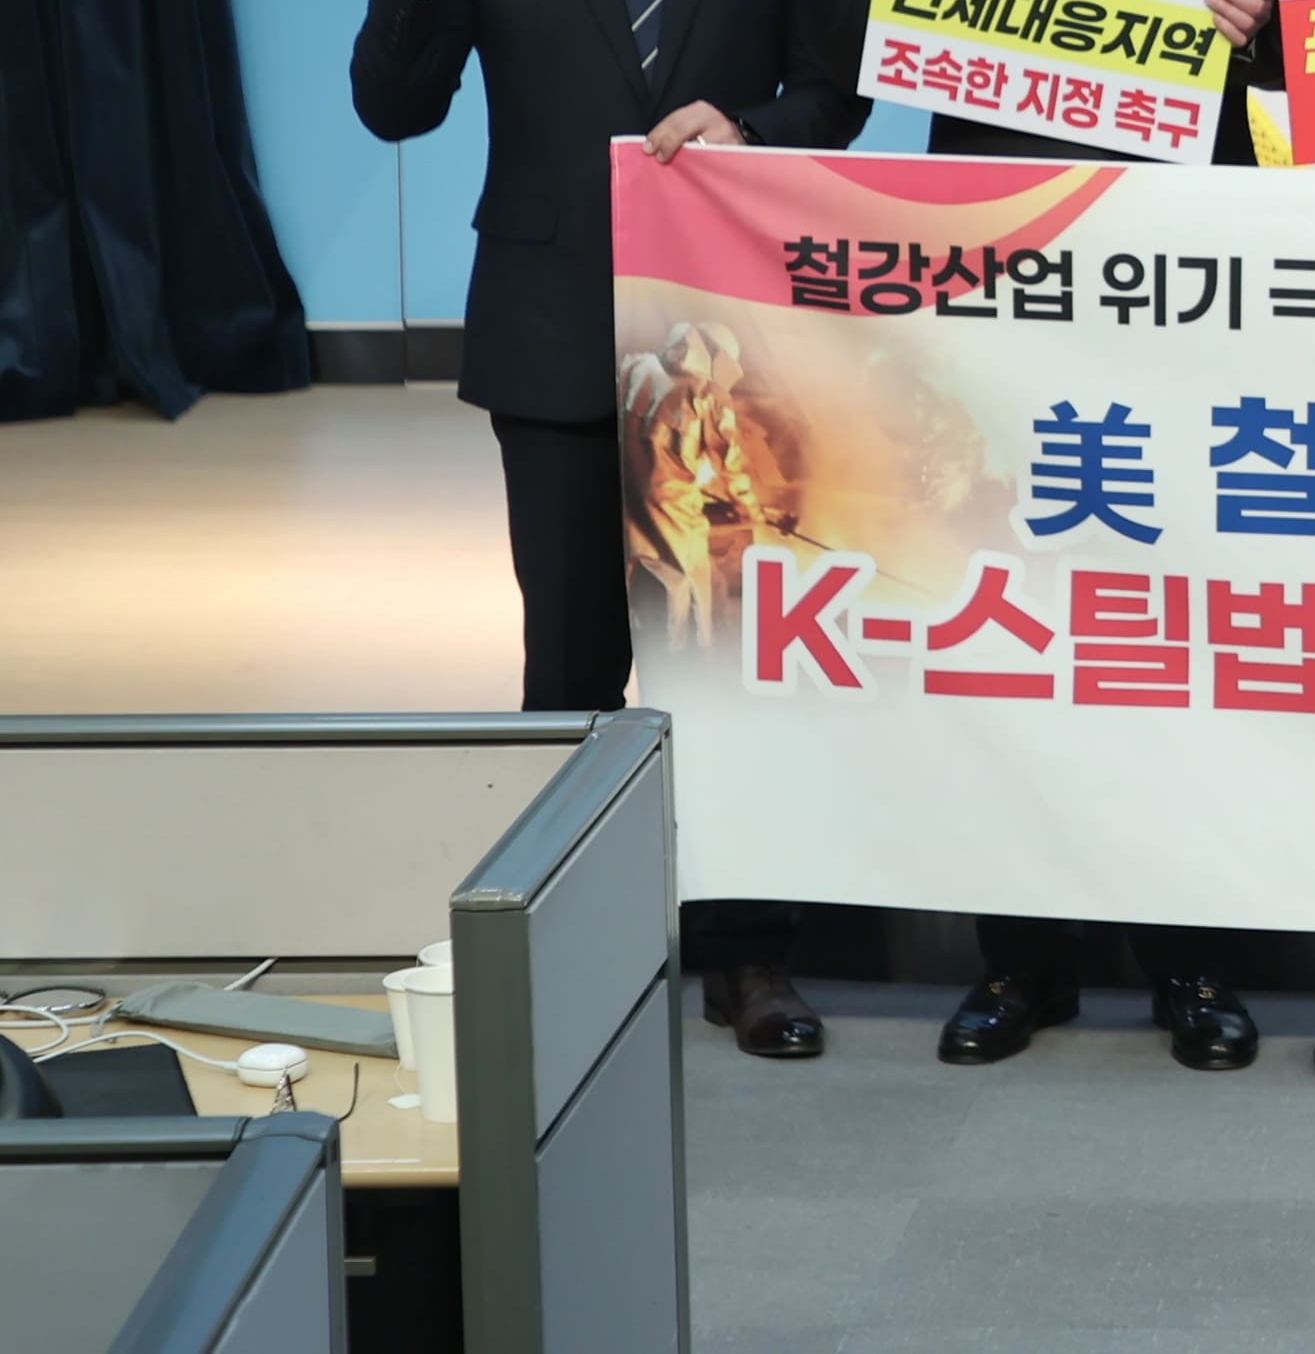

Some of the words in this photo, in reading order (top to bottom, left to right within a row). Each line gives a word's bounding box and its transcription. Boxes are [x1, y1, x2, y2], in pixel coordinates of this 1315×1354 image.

[877, 38, 1007, 110] 조속한
[1016, 68, 1104, 129] 지정
[1114, 89, 1201, 148] 촉구
[783, 235, 1074, 322] 철강산업
[1100, 253, 1243, 330] 위기
[1024, 399, 1163, 546] 美
